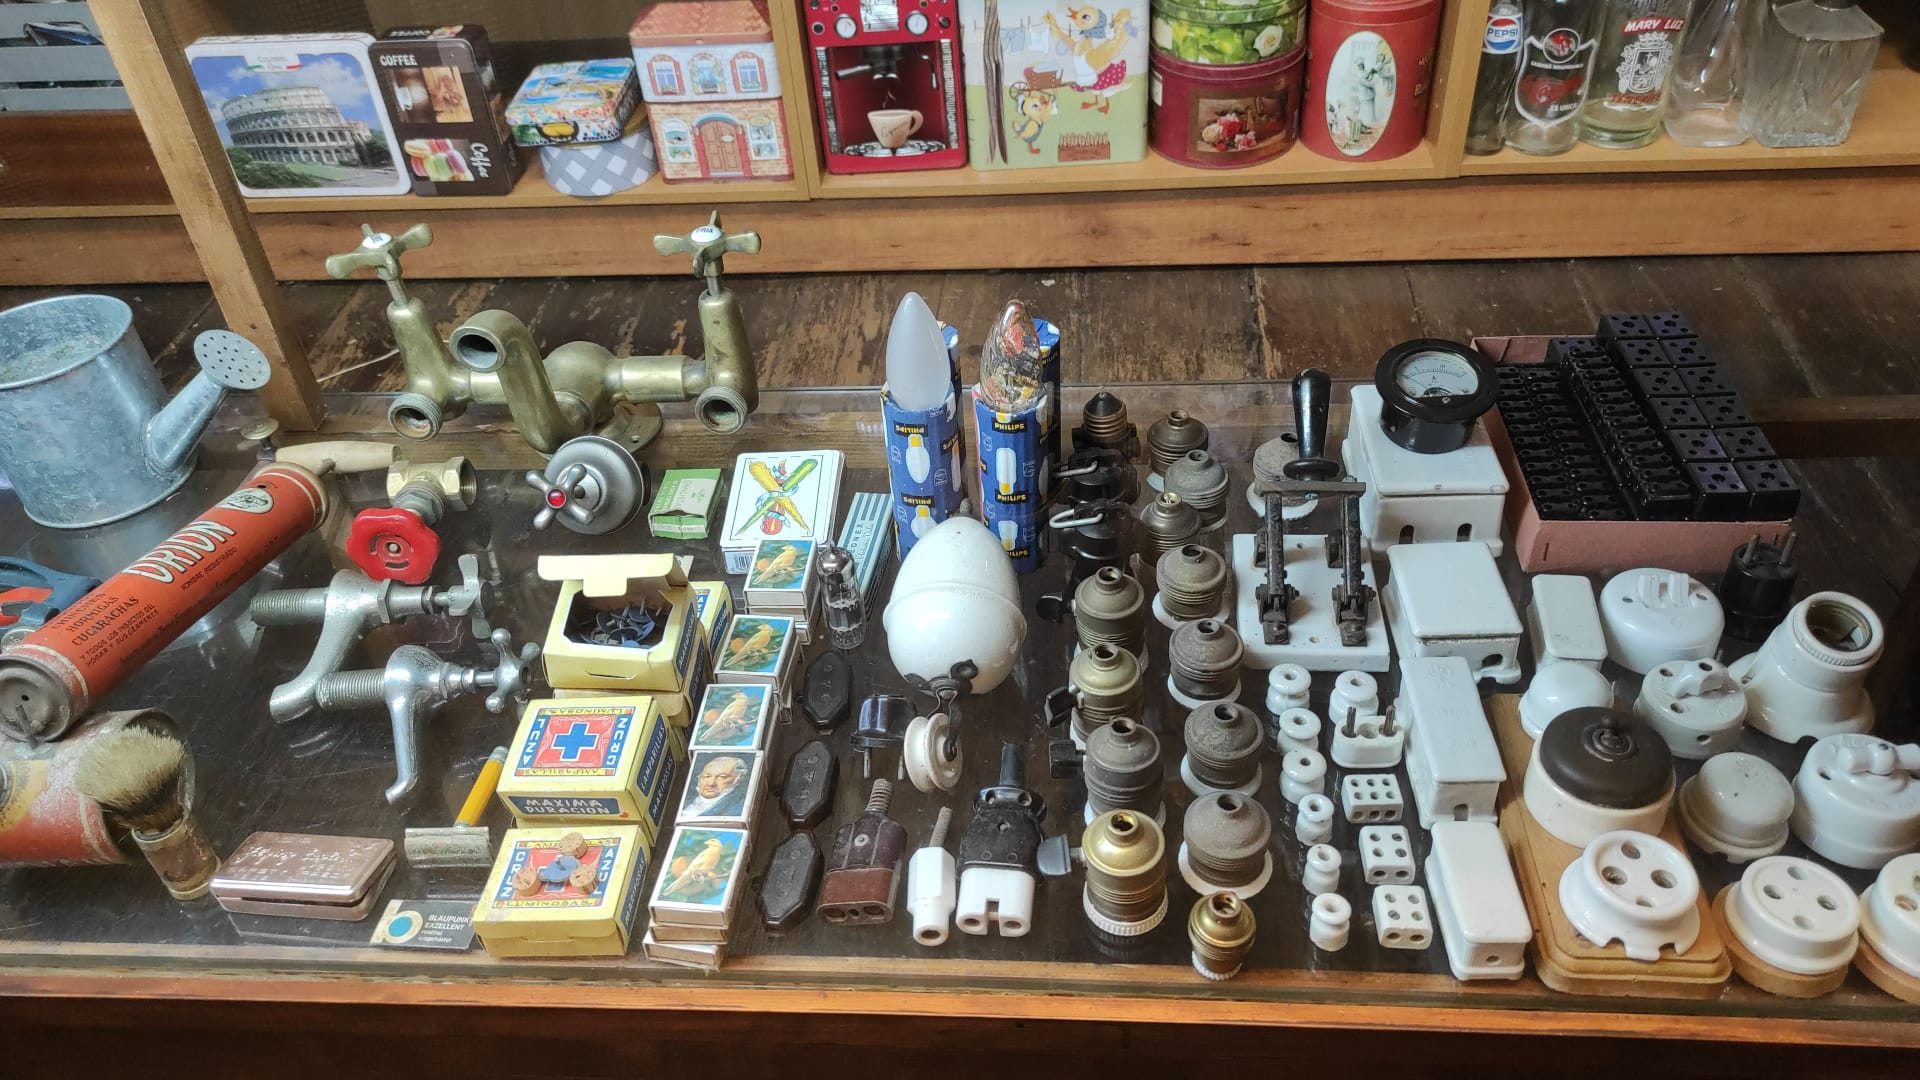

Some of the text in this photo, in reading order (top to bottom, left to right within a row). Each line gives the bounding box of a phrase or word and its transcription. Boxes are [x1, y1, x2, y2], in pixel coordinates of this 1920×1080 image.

[1487, 27, 1518, 37] PEPSI
[1624, 18, 1684, 32] MARY LUZ
[379, 54, 418, 67] COFFEE
[470, 142, 493, 178] Coffee
[895, 424, 925, 434] PHILIPS
[994, 422, 1025, 431] PHILIPS
[903, 496, 932, 505] PHILIPS
[997, 493, 1027, 502] PHILIPS
[181, 571, 204, 591] NOMBRE
[204, 547, 238, 577] REGISTRADO
[66, 596, 119, 632] HORMIGAS
[72, 596, 140, 646] CUCARACHAS
[85, 638, 108, 656] TODOS
[107, 629, 119, 641] LOS
[119, 609, 144, 633] INSECTOS
[86, 646, 110, 667] HOGAR
[522, 718, 545, 765] AZUL
[606, 717, 629, 765] CRUZ
[640, 726, 665, 791] LAMPARILLAS
[652, 757, 674, 818] MARIPOSAS
[525, 806, 610, 815] DURACION
[526, 799, 603, 808] MAXIMA
[625, 857, 645, 925] MARIPOSAS
[424, 922, 465, 931] EXZELLENT
